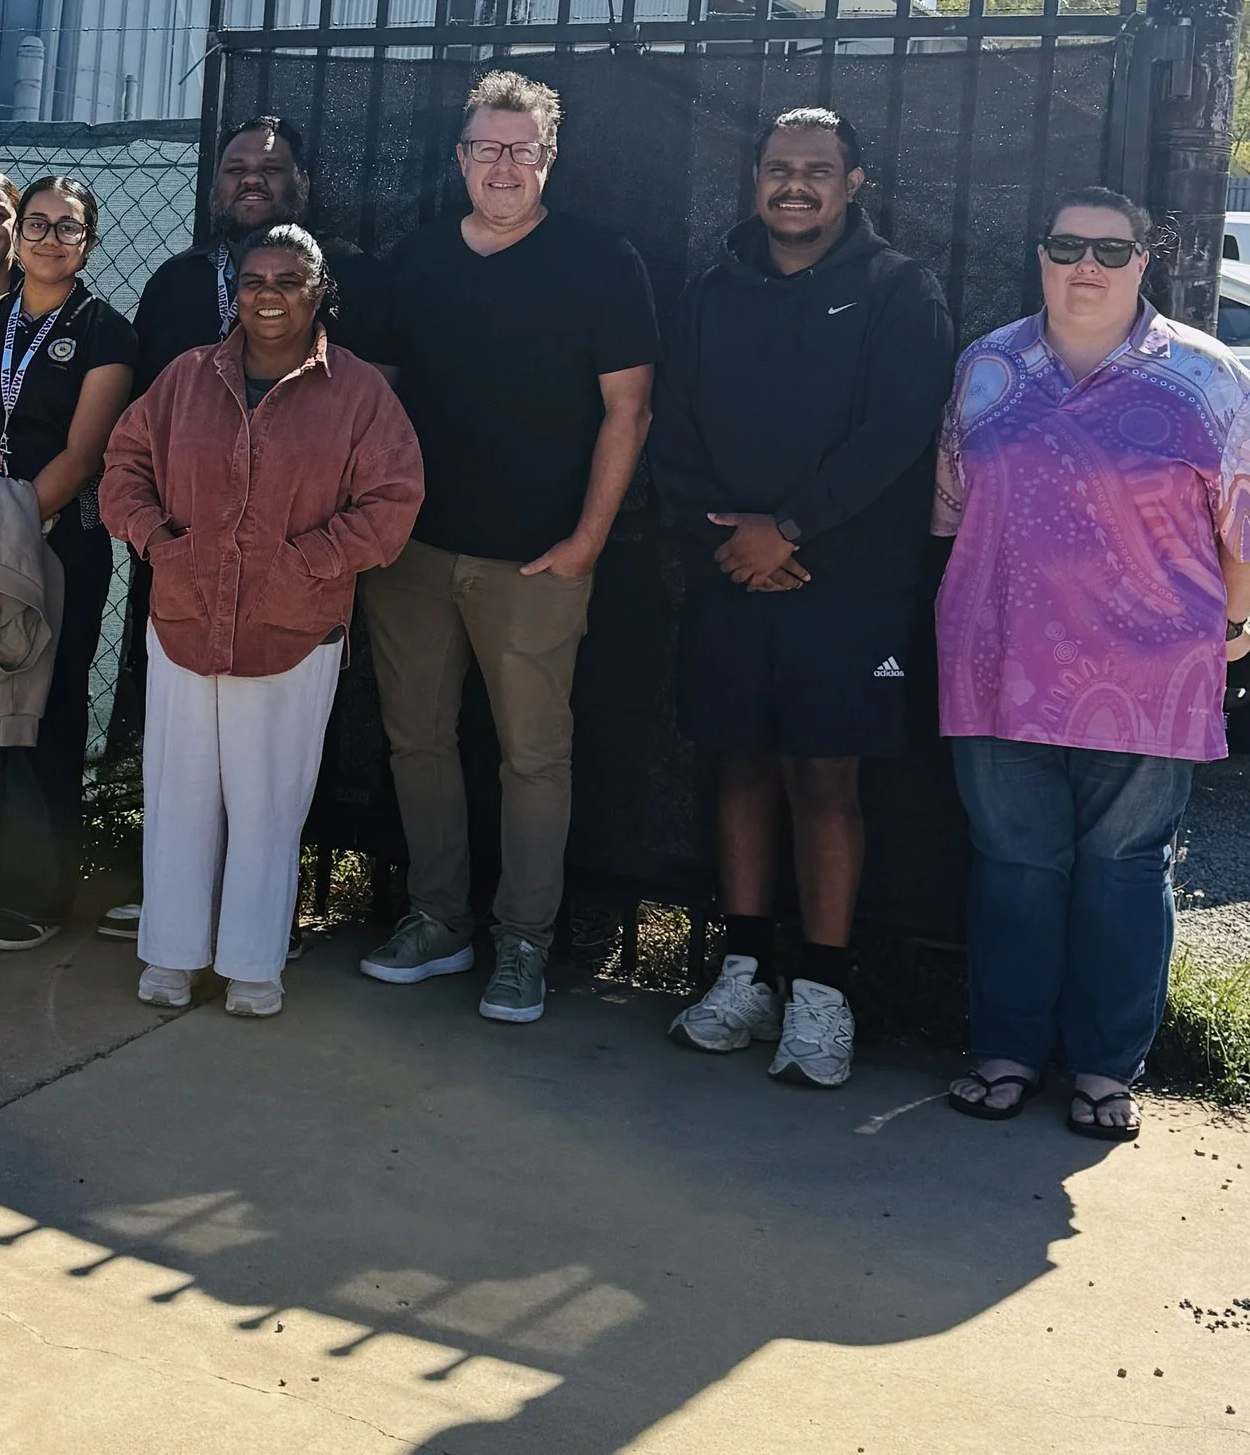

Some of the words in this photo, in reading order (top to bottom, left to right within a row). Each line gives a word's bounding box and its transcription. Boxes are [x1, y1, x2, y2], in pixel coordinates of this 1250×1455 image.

[5, 311, 19, 350] AIDRWA
[30, 313, 58, 352] AIDRWA
[873, 668, 905, 678] adidas
